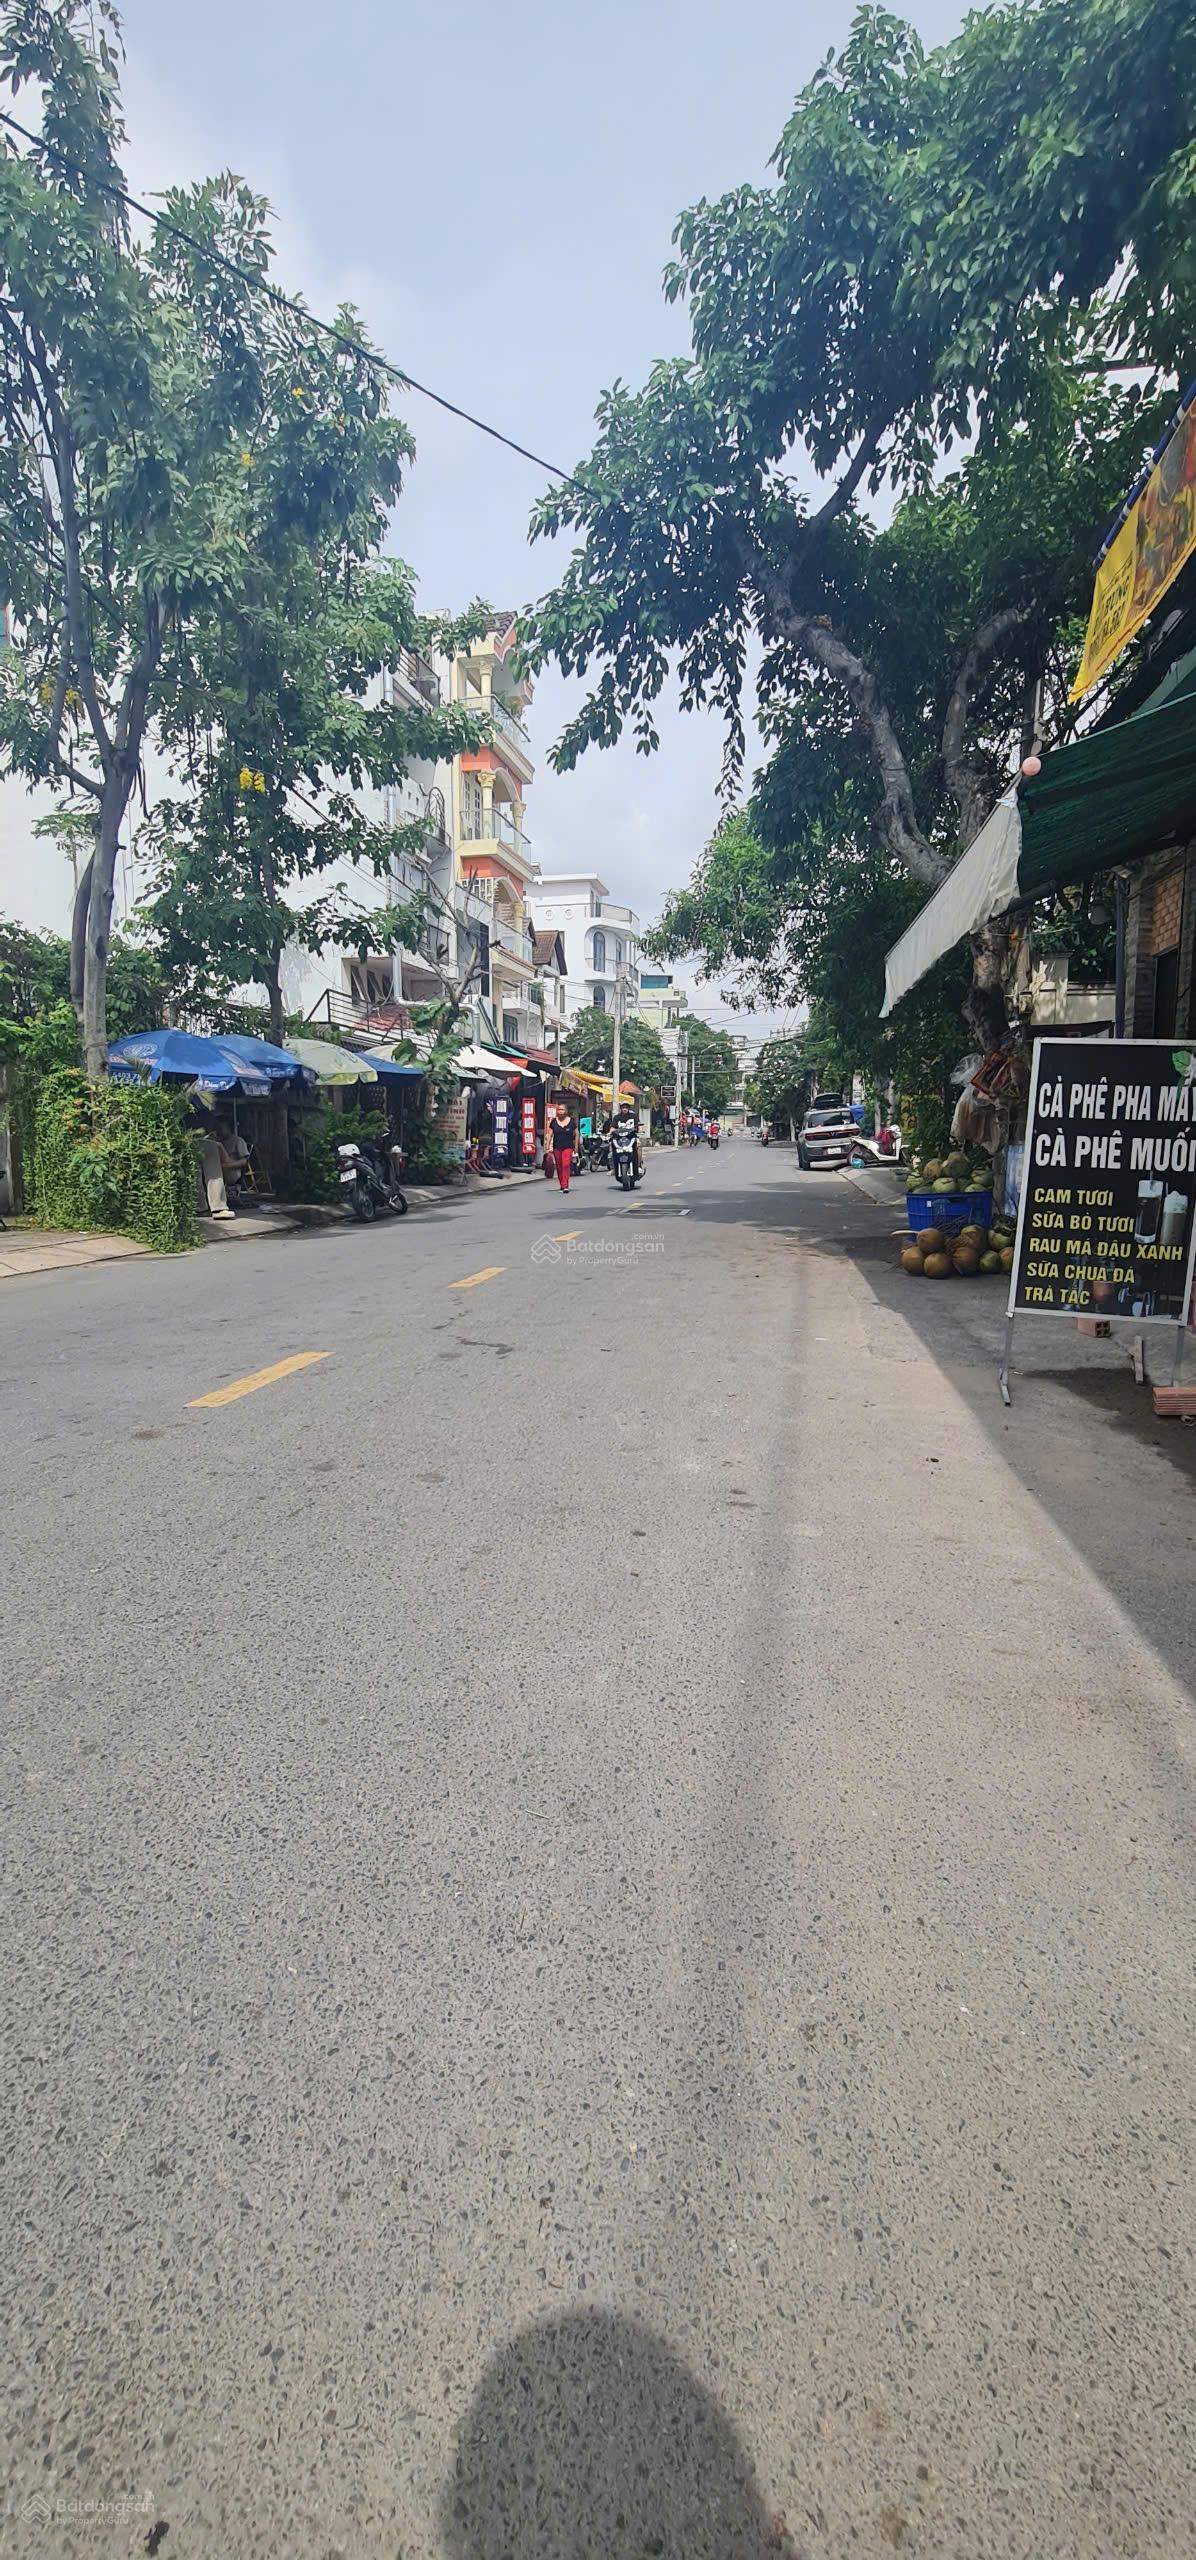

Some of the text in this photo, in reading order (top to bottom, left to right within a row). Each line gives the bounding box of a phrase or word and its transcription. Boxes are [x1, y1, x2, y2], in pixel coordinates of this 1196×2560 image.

[1038, 1075, 1064, 1119] CÀ
[1068, 1076, 1108, 1120] PHÊ
[1111, 1084, 1151, 1121] PHA
[1035, 1127, 1067, 1167] CÀ
[1074, 1129, 1123, 1170] PHÊ
[1033, 1187, 1114, 1207] CAM TƯƠI
[1031, 1210, 1135, 1233] SỮA BÒ TƯƠI
[1029, 1237, 1183, 1261] RAU MÁ ĐẬU XANH
[1026, 1260, 1135, 1284] SỮA CHUA ĐÁ
[1024, 1284, 1091, 1305] TRÀ TẮC
